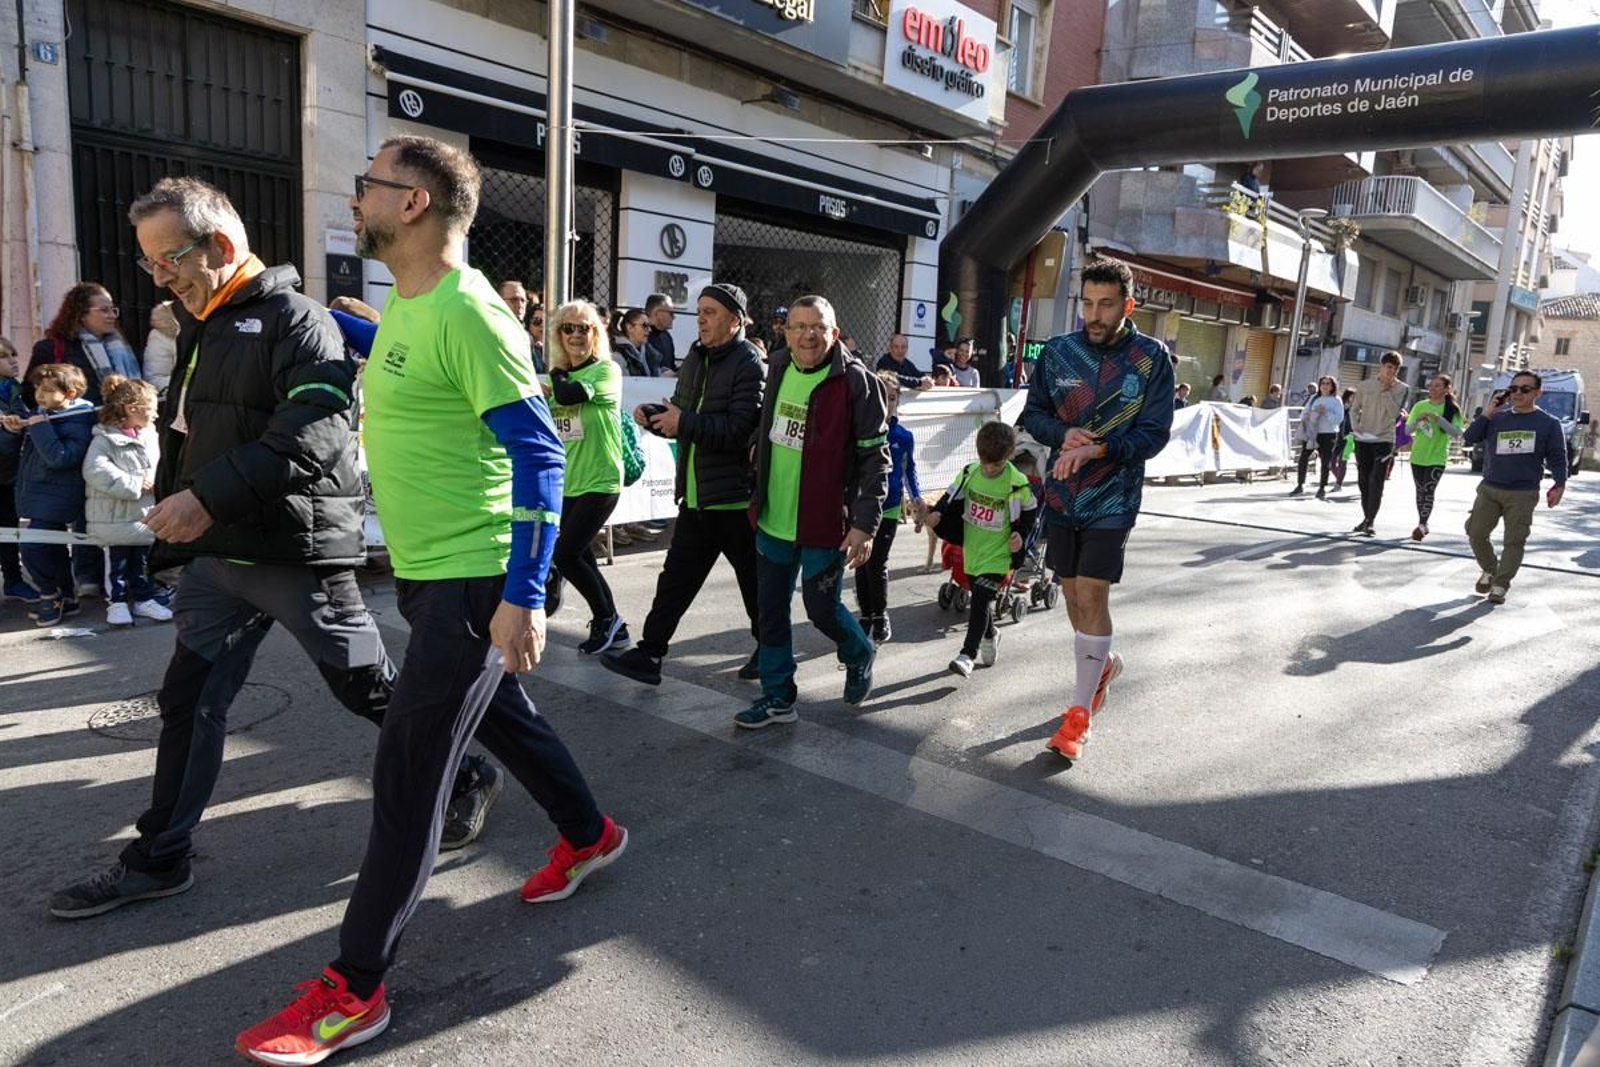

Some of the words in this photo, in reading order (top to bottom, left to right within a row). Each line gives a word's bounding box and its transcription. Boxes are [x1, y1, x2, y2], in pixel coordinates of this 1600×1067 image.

[764, 0, 814, 24] egal
[902, 45, 944, 82] diseño
[944, 69, 984, 98] gráfico
[1267, 84, 1349, 102] Patronato
[1354, 69, 1443, 93] Municipal
[1449, 68, 1474, 83] de
[1266, 102, 1342, 122] Deportes
[1347, 97, 1370, 112] de
[1374, 92, 1419, 111] Jaén
[819, 195, 846, 218] PASOS
[553, 418, 572, 432] 49
[785, 419, 806, 440] 185
[1508, 439, 1522, 449] 52
[642, 478, 673, 488] Patronato
[971, 503, 994, 522] 920
